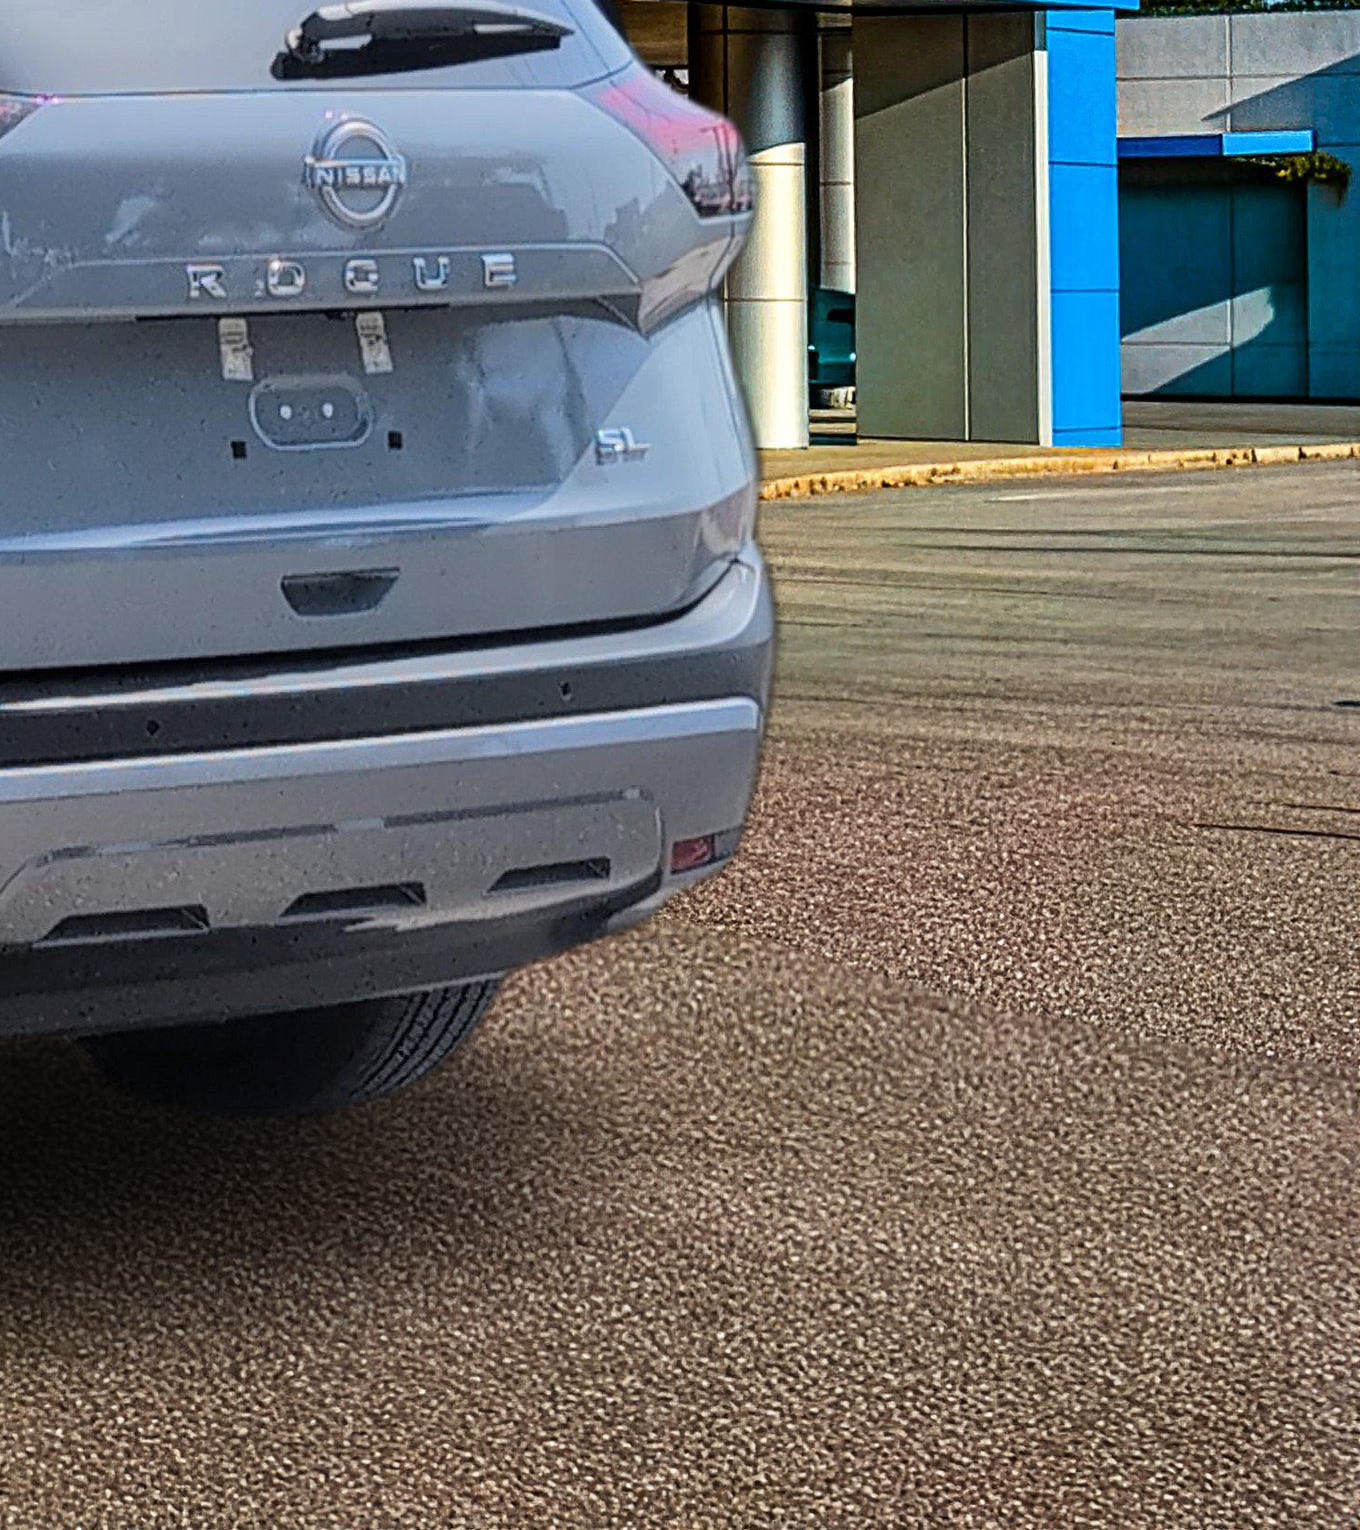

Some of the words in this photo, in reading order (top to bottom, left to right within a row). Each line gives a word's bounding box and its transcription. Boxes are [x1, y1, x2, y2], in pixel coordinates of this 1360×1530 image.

[313, 165, 401, 187] NISSAN
[185, 253, 518, 299] ROGUE
[597, 426, 651, 460] SL
